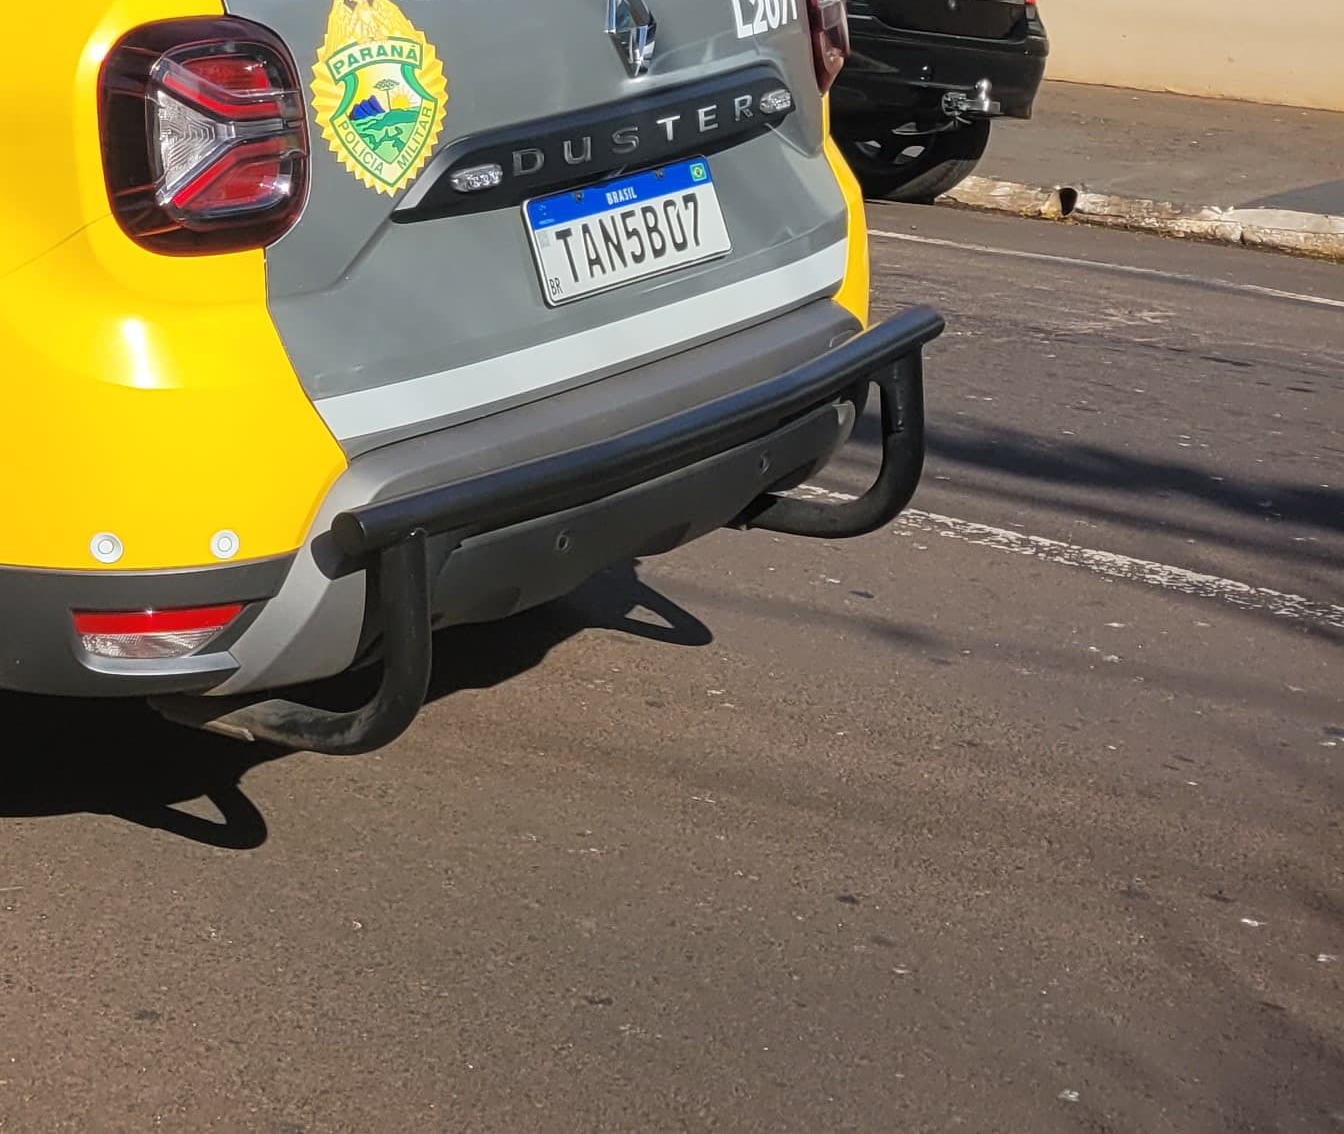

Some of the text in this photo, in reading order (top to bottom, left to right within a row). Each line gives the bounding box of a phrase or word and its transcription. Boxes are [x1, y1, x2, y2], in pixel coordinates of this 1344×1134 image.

[333, 44, 419, 76] PARANÁ
[396, 106, 433, 170] MILITAR
[512, 94, 754, 177] DUSTER
[605, 186, 638, 206] BRASIL
[554, 192, 701, 283] TAN5B07
[548, 277, 564, 296] BR
